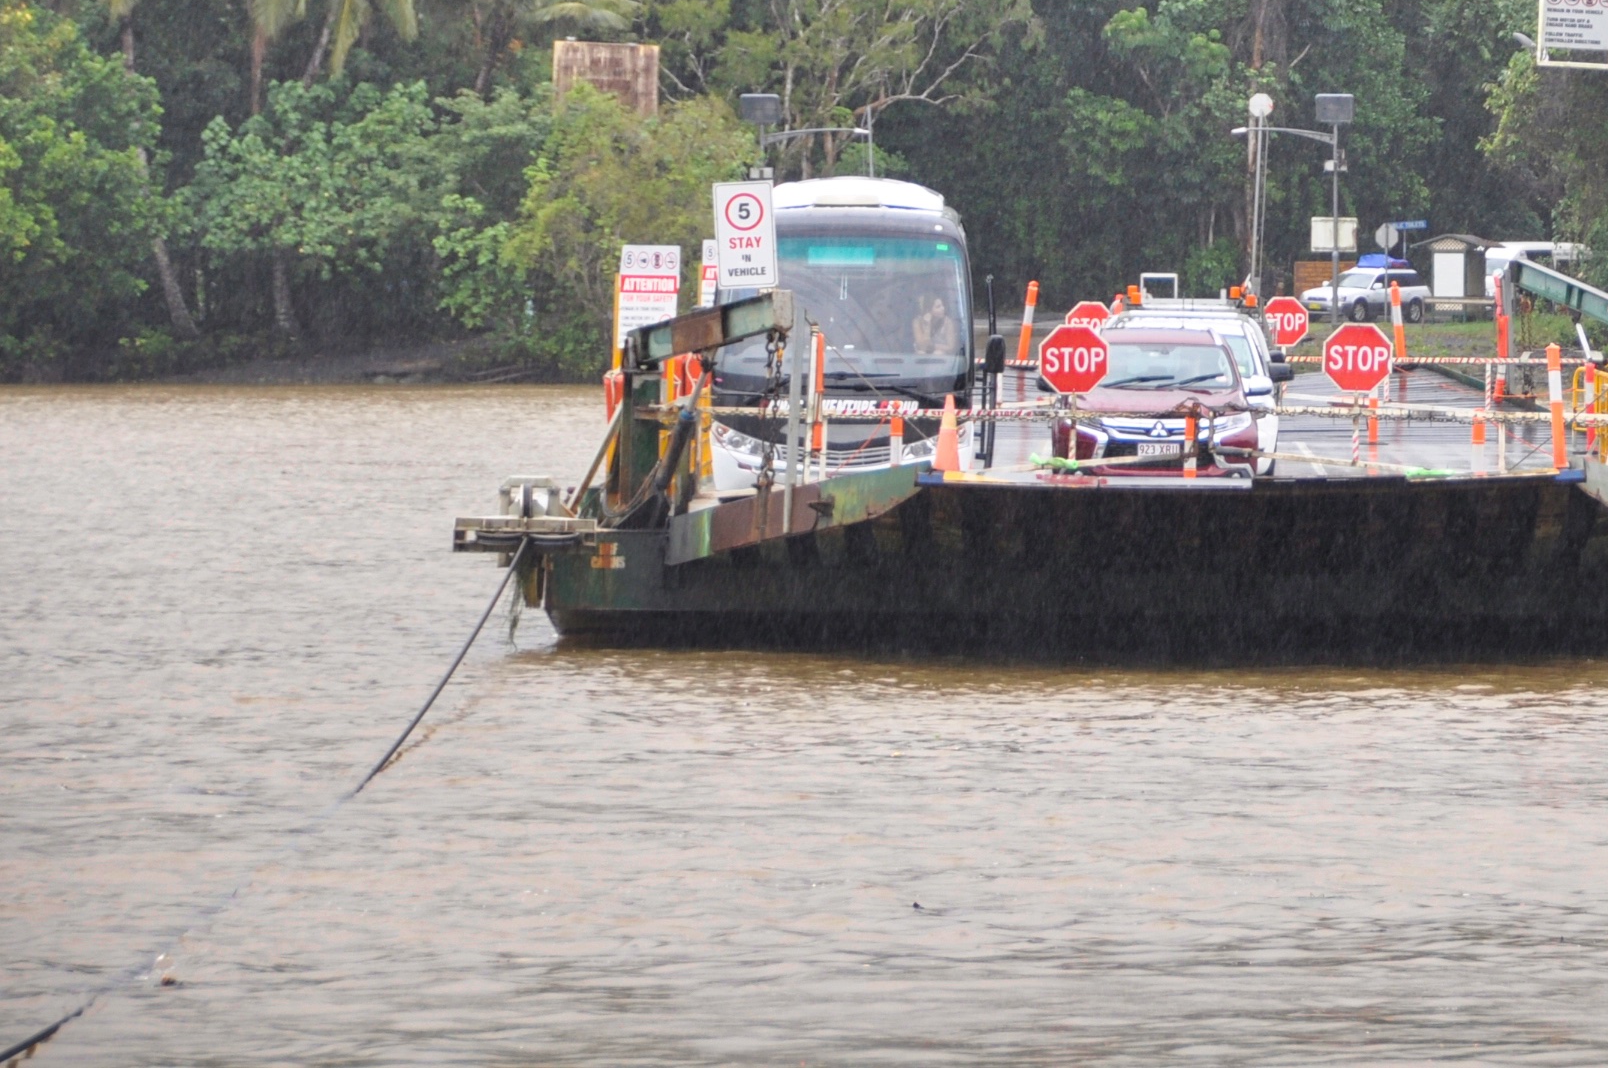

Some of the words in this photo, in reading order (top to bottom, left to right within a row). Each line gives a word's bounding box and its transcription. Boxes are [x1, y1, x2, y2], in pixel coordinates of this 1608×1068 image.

[738, 203, 750, 220] 5
[729, 236, 762, 249] STAY
[627, 255, 632, 265] 5
[742, 254, 751, 262] IN
[728, 266, 766, 277] VEHICLE
[623, 277, 675, 291] ATTENTION
[653, 295, 673, 303] SAFETY
[1045, 347, 1105, 372] STOP
[1329, 345, 1388, 371] STOP
[1140, 445, 1156, 455] 923
